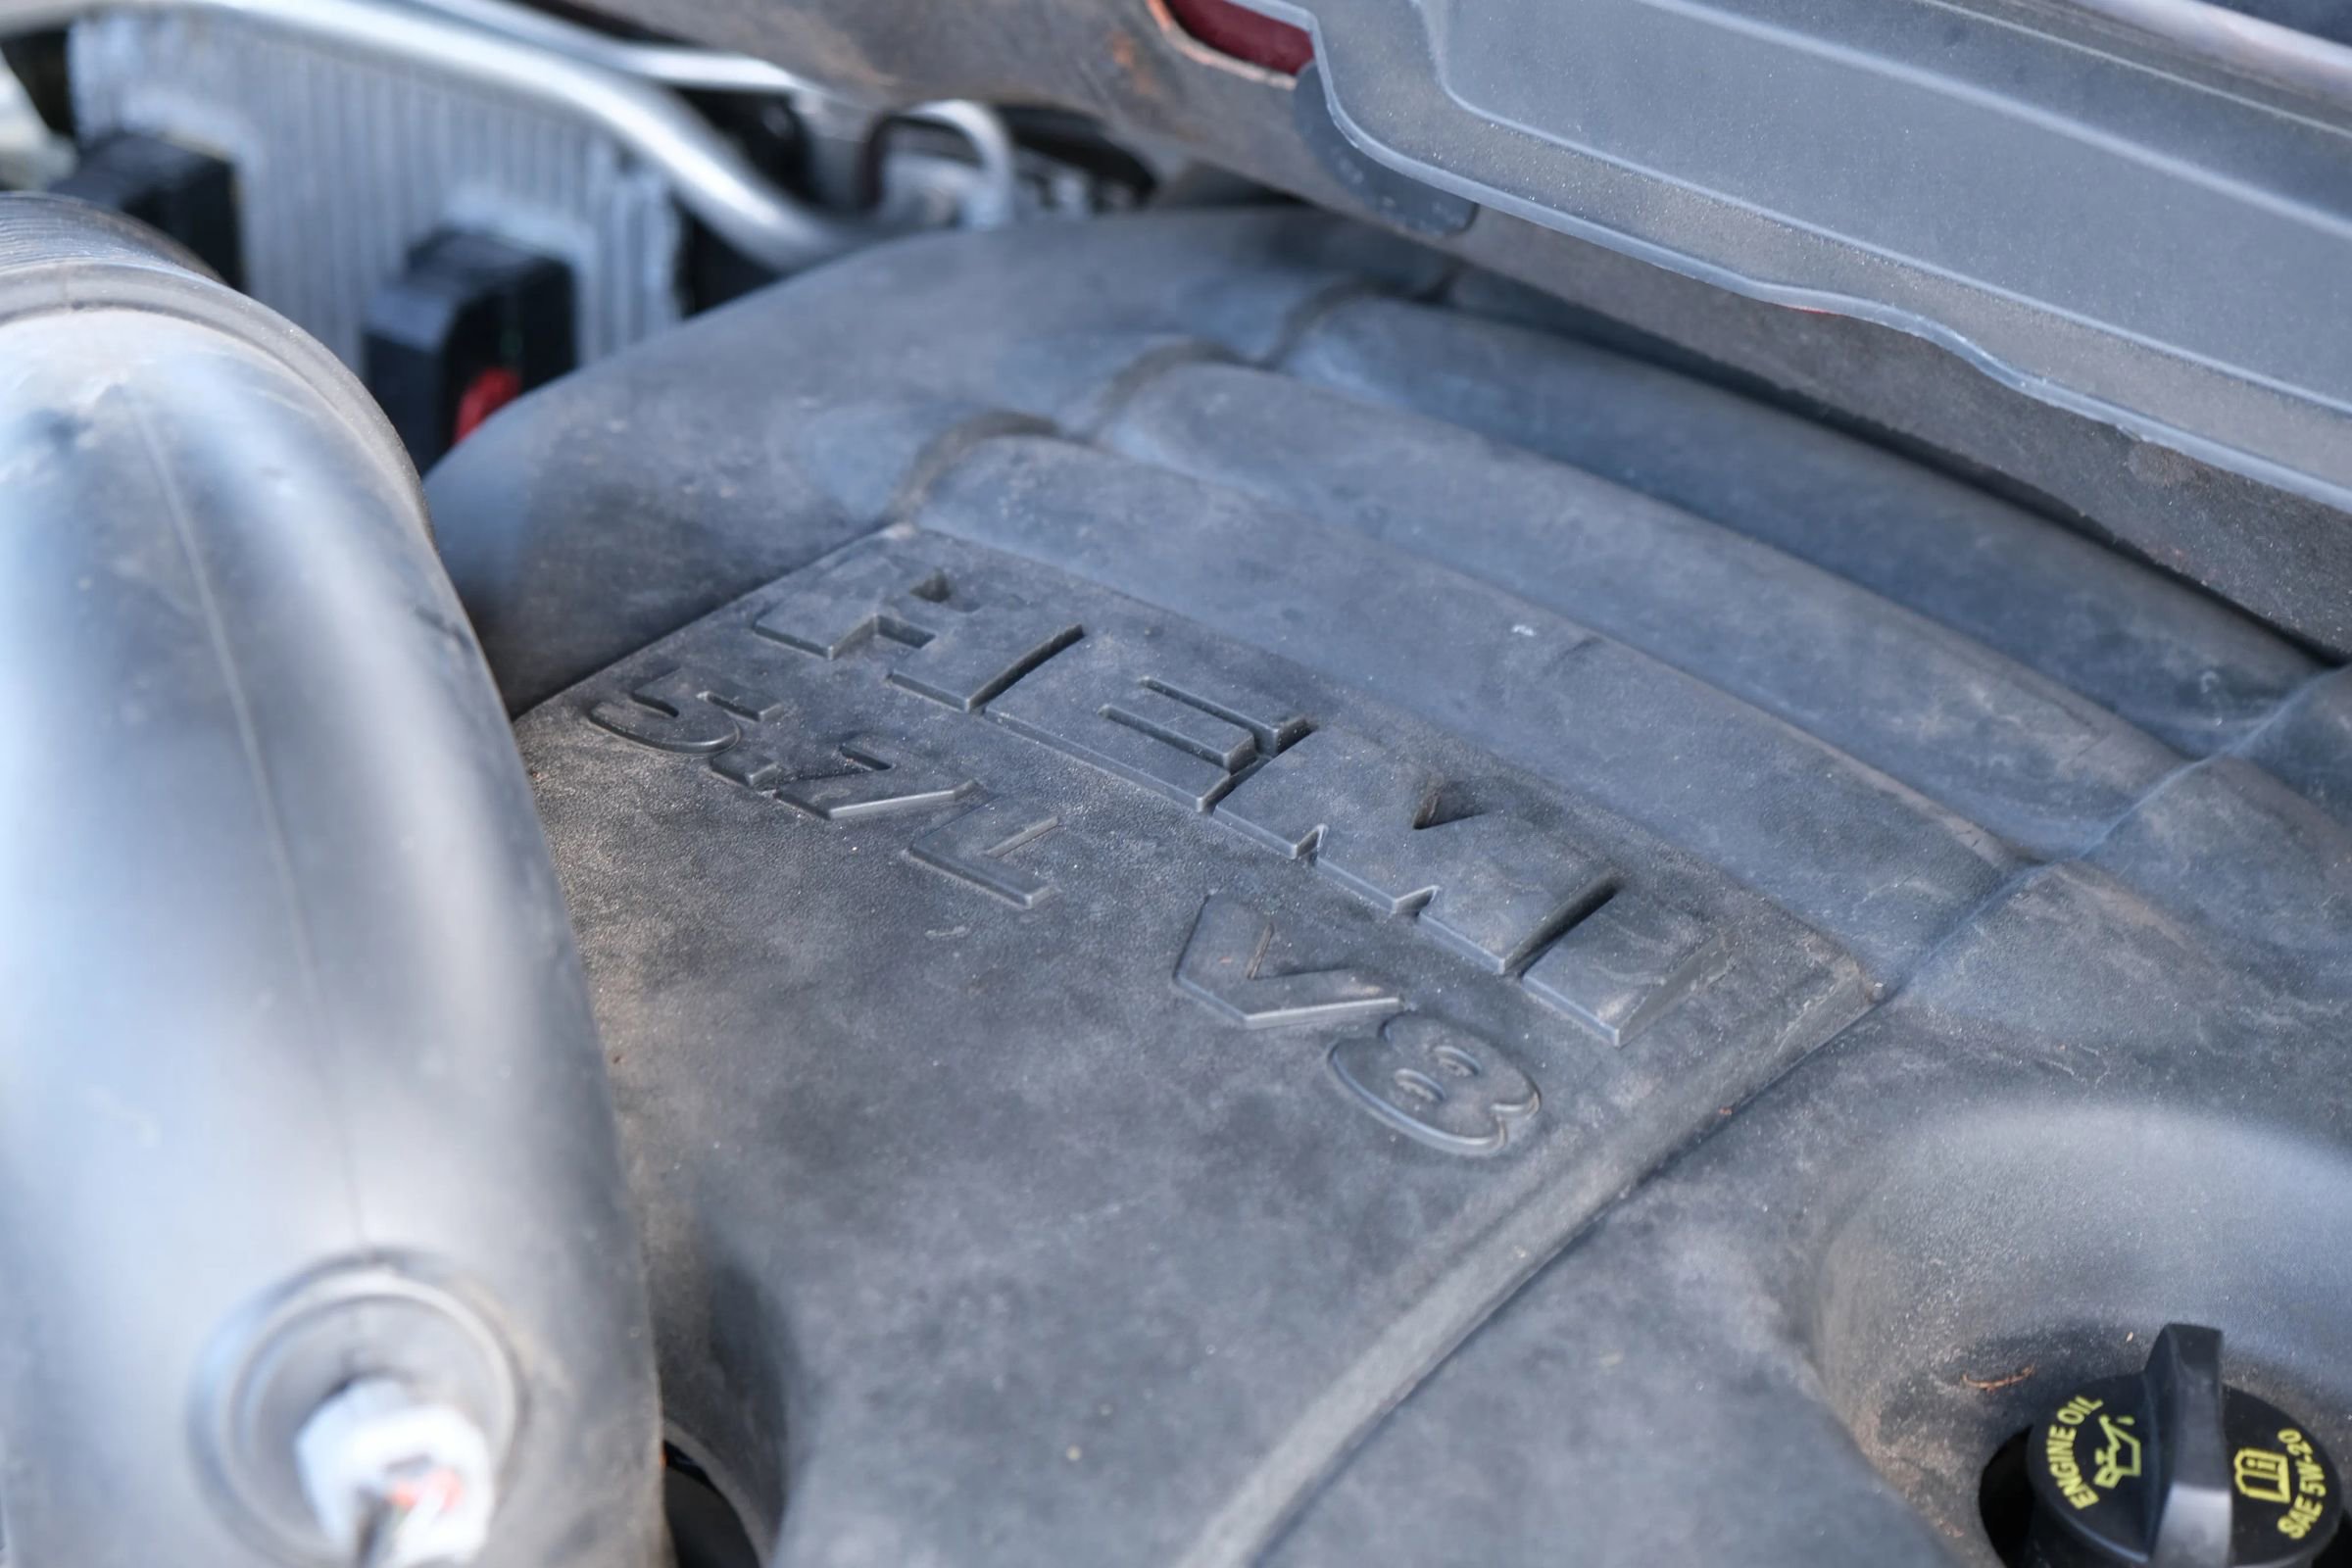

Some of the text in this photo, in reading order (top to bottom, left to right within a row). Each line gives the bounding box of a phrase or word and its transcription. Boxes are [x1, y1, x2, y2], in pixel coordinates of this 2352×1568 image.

[751, 555, 1737, 1051] HEMI
[1172, 888, 1543, 1158] V8
[2046, 1395, 2104, 1509] ENGINE OIL
[2277, 1428, 2327, 1540] SAE 5W-20
